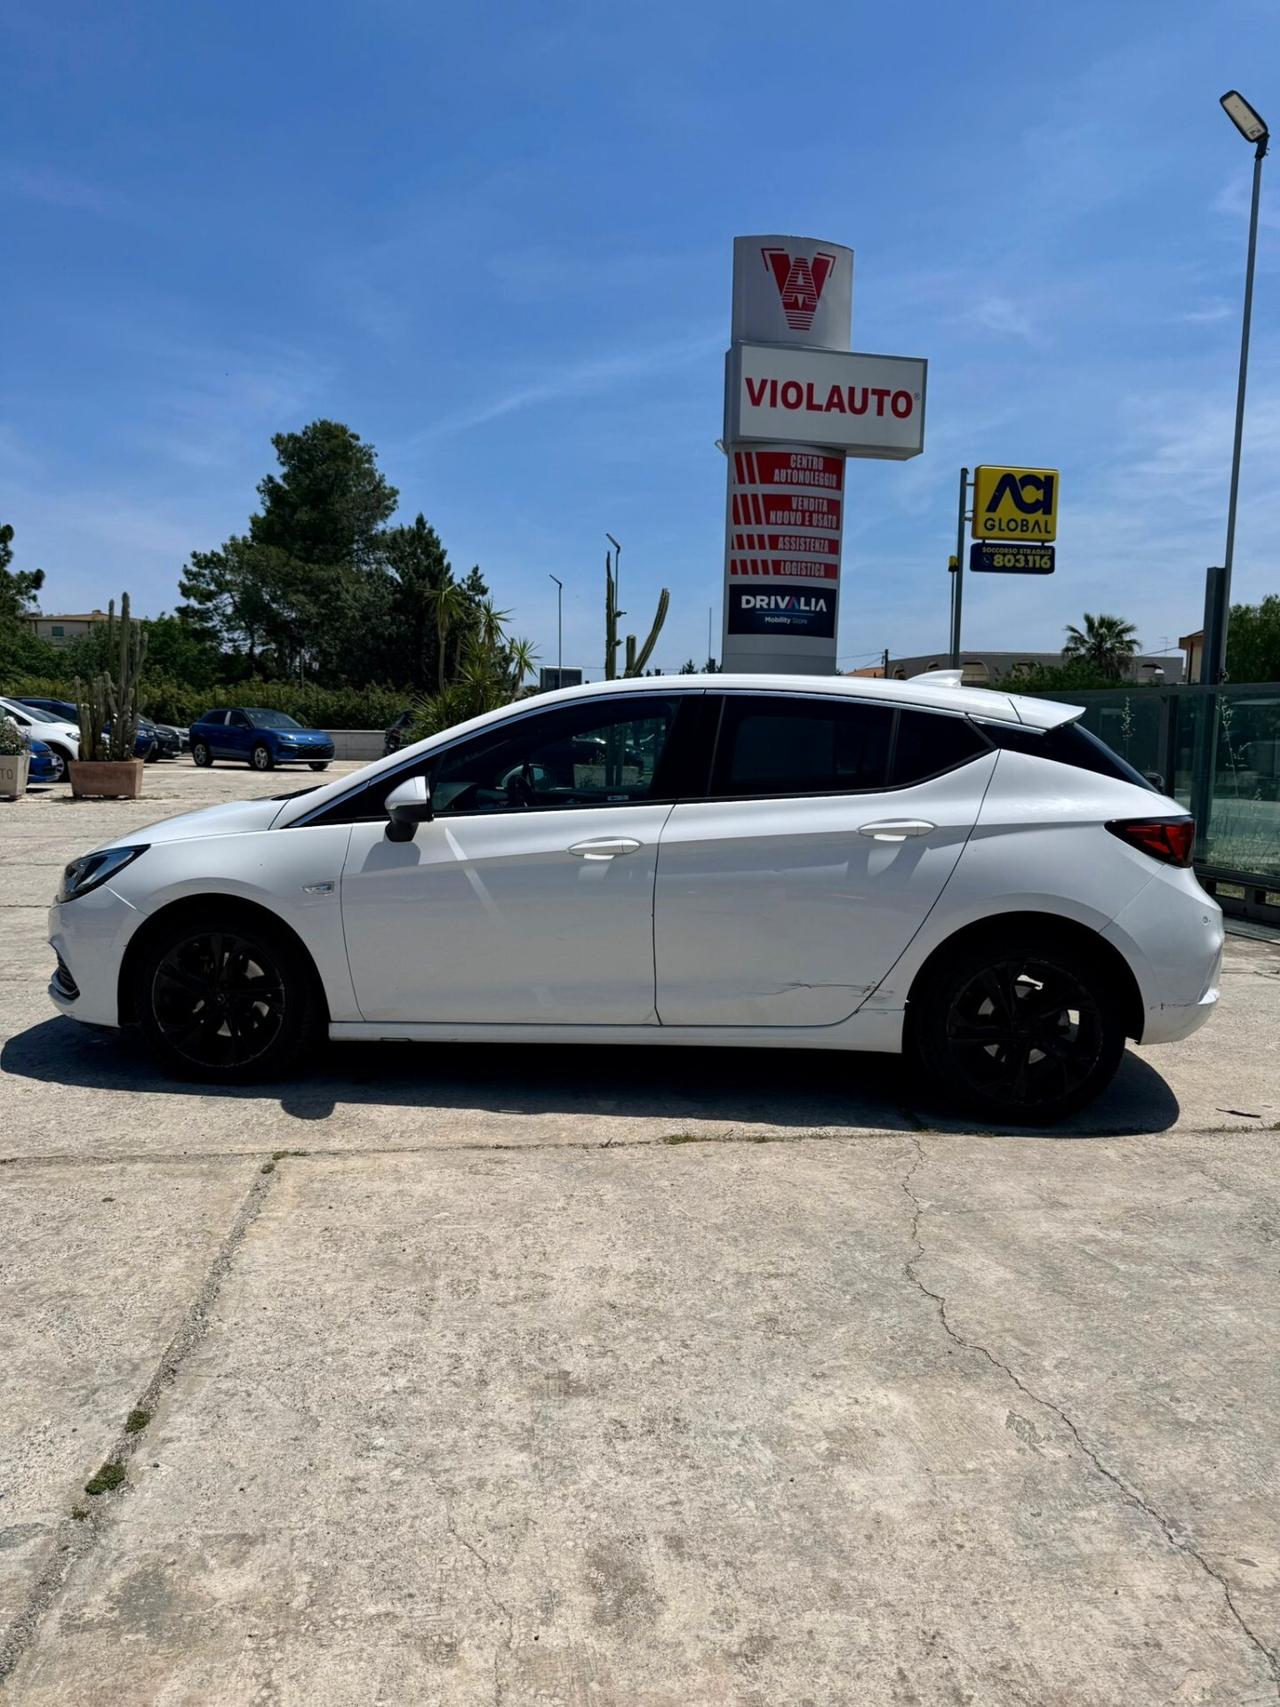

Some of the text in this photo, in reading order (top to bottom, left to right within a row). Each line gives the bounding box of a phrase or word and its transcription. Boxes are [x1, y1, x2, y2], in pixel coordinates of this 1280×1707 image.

[745, 377, 913, 419] VIOLAUTO
[791, 455, 824, 470] CENTRO
[774, 469, 837, 487] AUTONOLEGGIO
[986, 473, 1054, 515] ACI
[792, 497, 828, 512] VENDITA
[770, 511, 837, 528] NUOVO E USATO
[984, 517, 1051, 534] GLOBAL
[778, 536, 829, 552] ASSISTENZA
[780, 561, 825, 576] LOGISTICA
[741, 595, 827, 612] DRIVALIA
